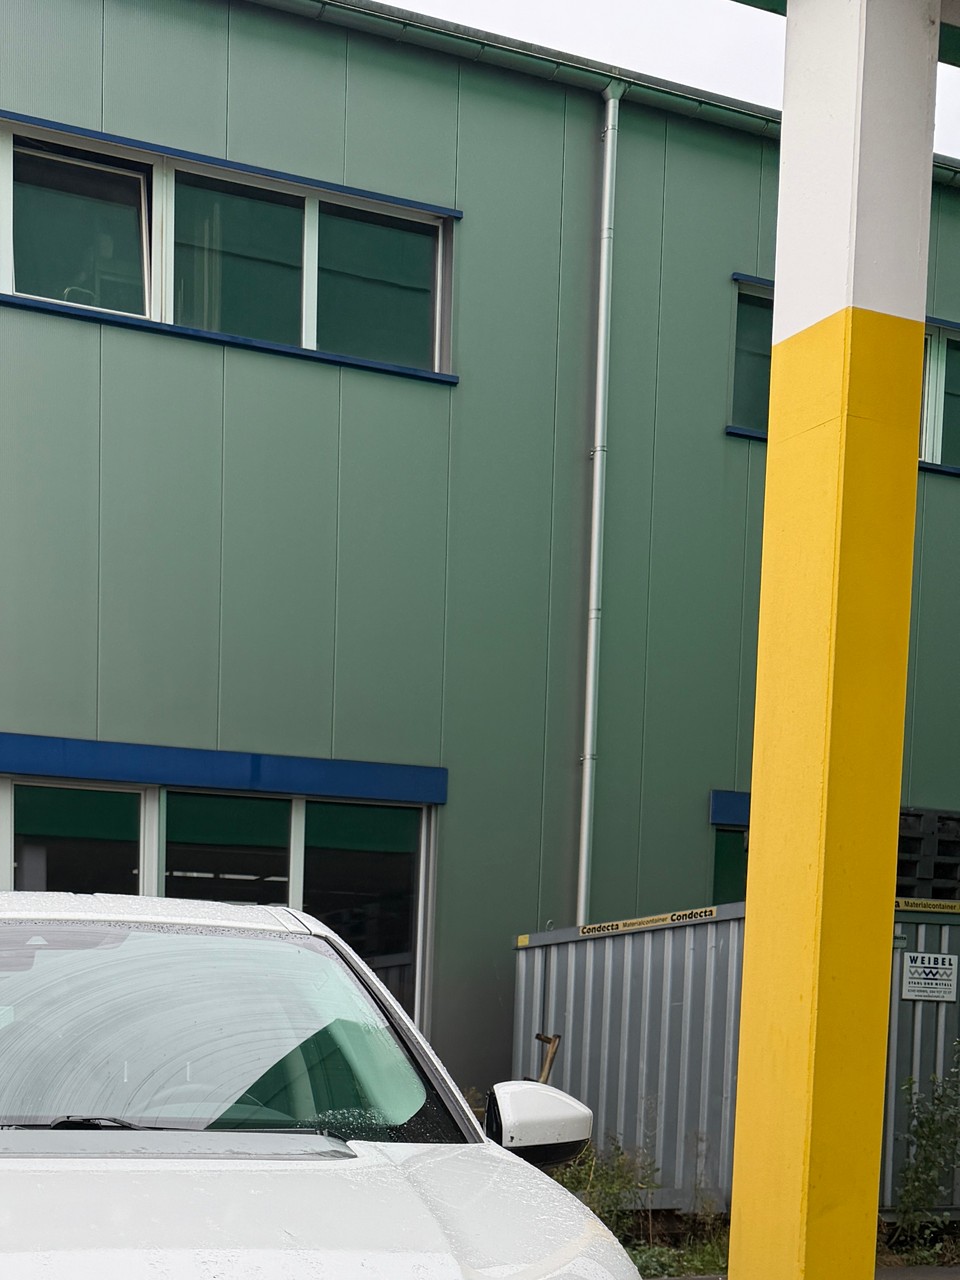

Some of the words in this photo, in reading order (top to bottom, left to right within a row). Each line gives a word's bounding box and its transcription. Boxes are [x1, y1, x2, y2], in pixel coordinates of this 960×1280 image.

[904, 900, 957, 910] Materialcontainer
[581, 922, 620, 935] Condecta
[622, 916, 668, 929] Materialcontainer
[670, 908, 714, 922] Condecta
[909, 955, 953, 966] WEIBEL
